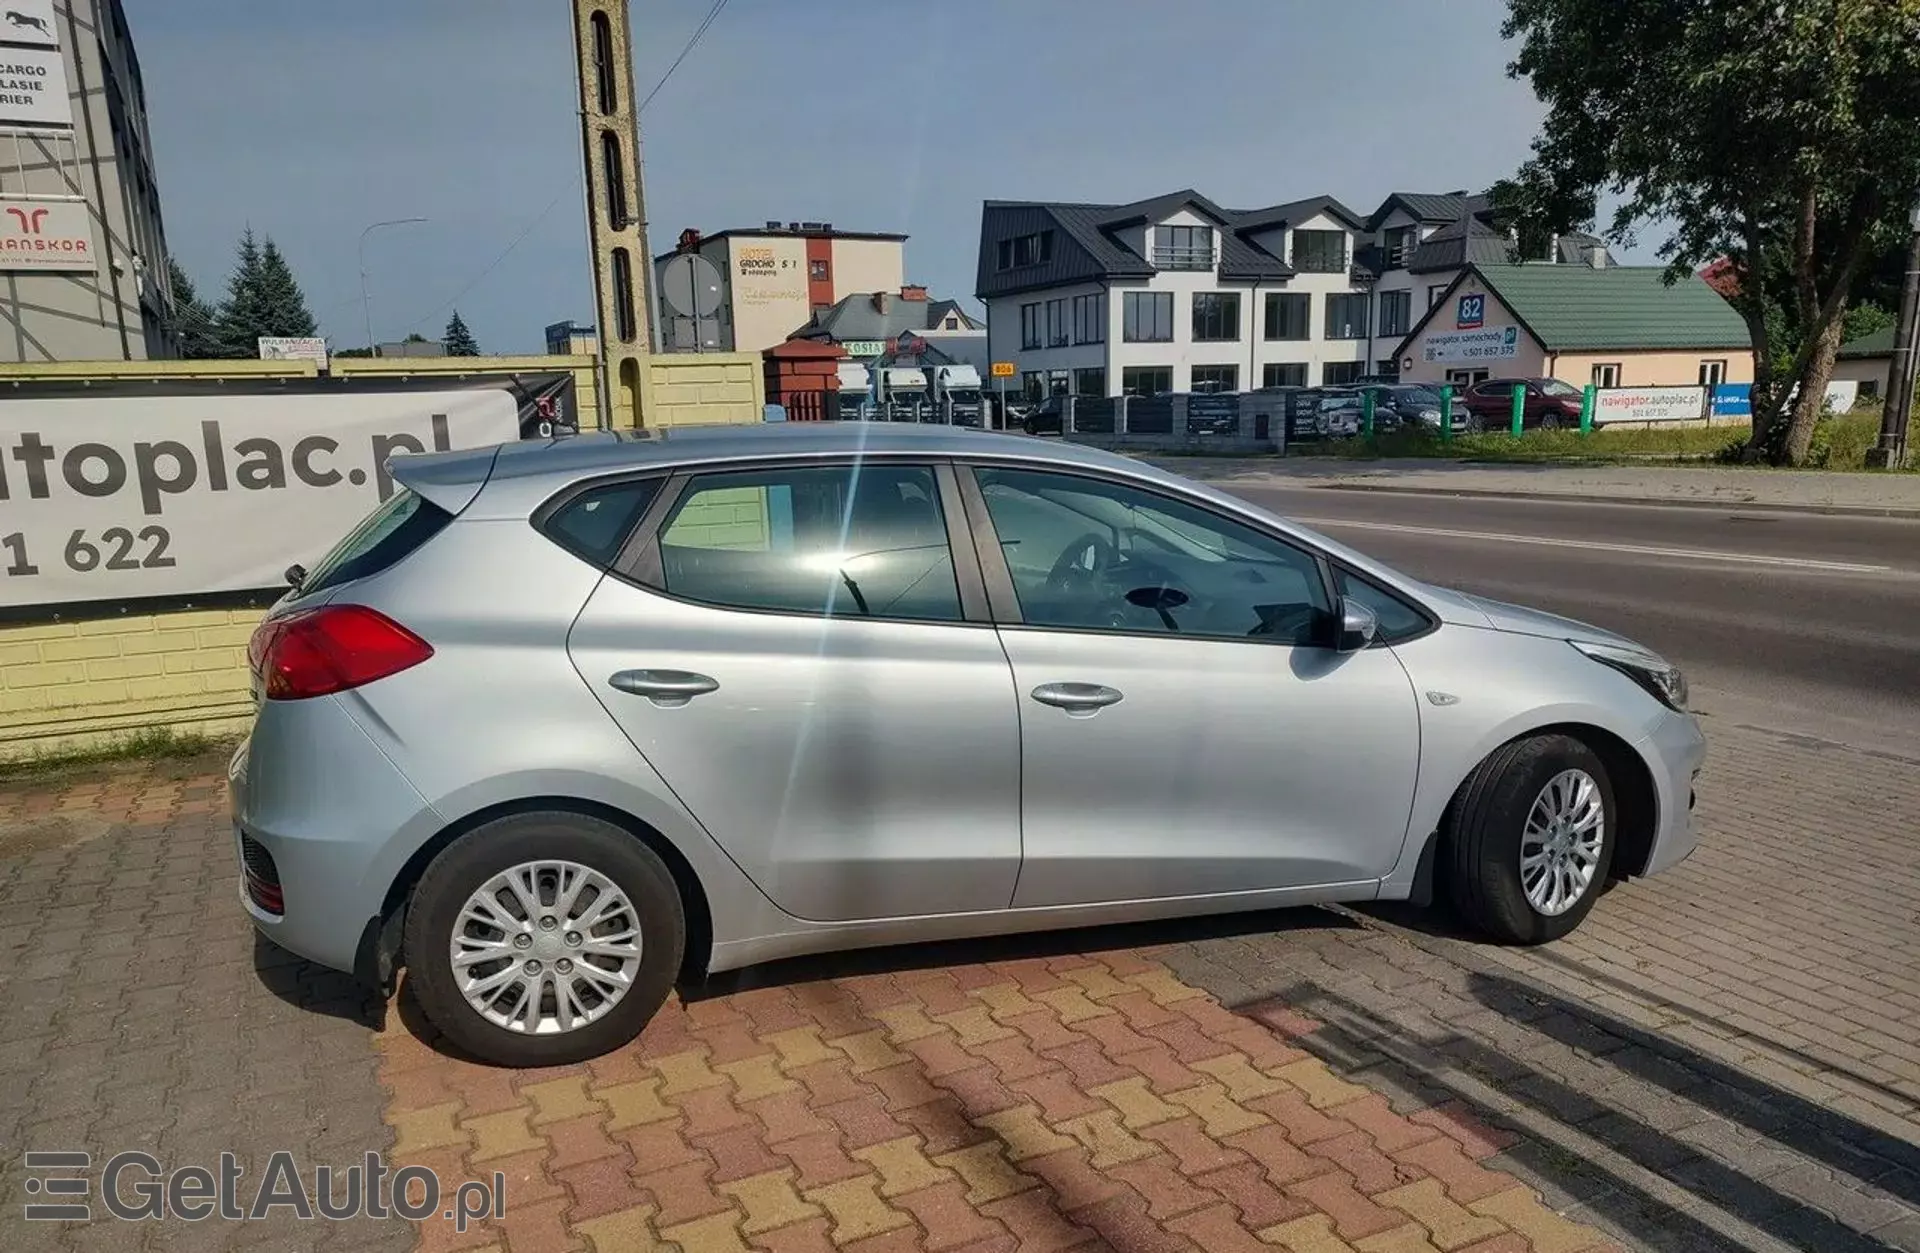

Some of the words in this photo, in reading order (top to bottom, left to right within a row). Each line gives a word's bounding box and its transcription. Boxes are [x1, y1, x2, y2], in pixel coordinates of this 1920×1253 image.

[1462, 298, 1480, 318] 82
[0, 414, 450, 514] toplac.pl
[2, 533, 39, 576] 1
[63, 525, 176, 572] 622
